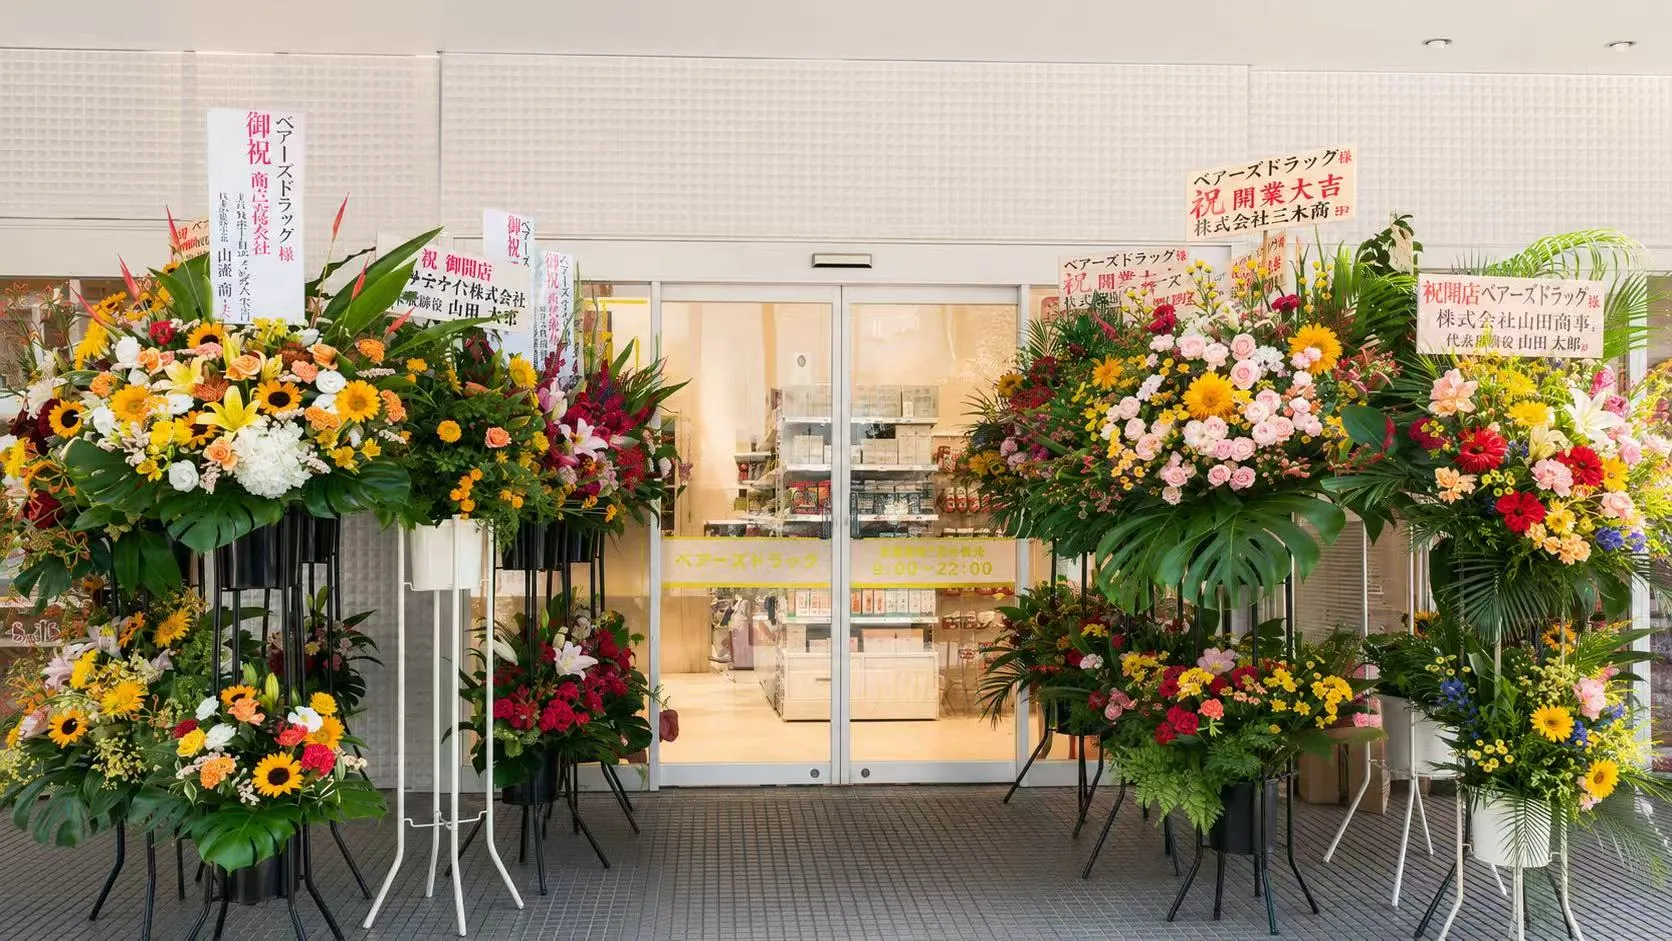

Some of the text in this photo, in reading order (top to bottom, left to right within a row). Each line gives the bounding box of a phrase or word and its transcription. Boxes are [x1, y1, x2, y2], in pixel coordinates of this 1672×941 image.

[246, 111, 272, 165] 御祝
[1193, 149, 1352, 187] ベアーズドラッグ様
[1190, 173, 1344, 220] 祝 開業大吉
[508, 215, 521, 259] 御祝
[421, 248, 493, 281] 祝 御開店
[1063, 272, 1092, 295] 祝
